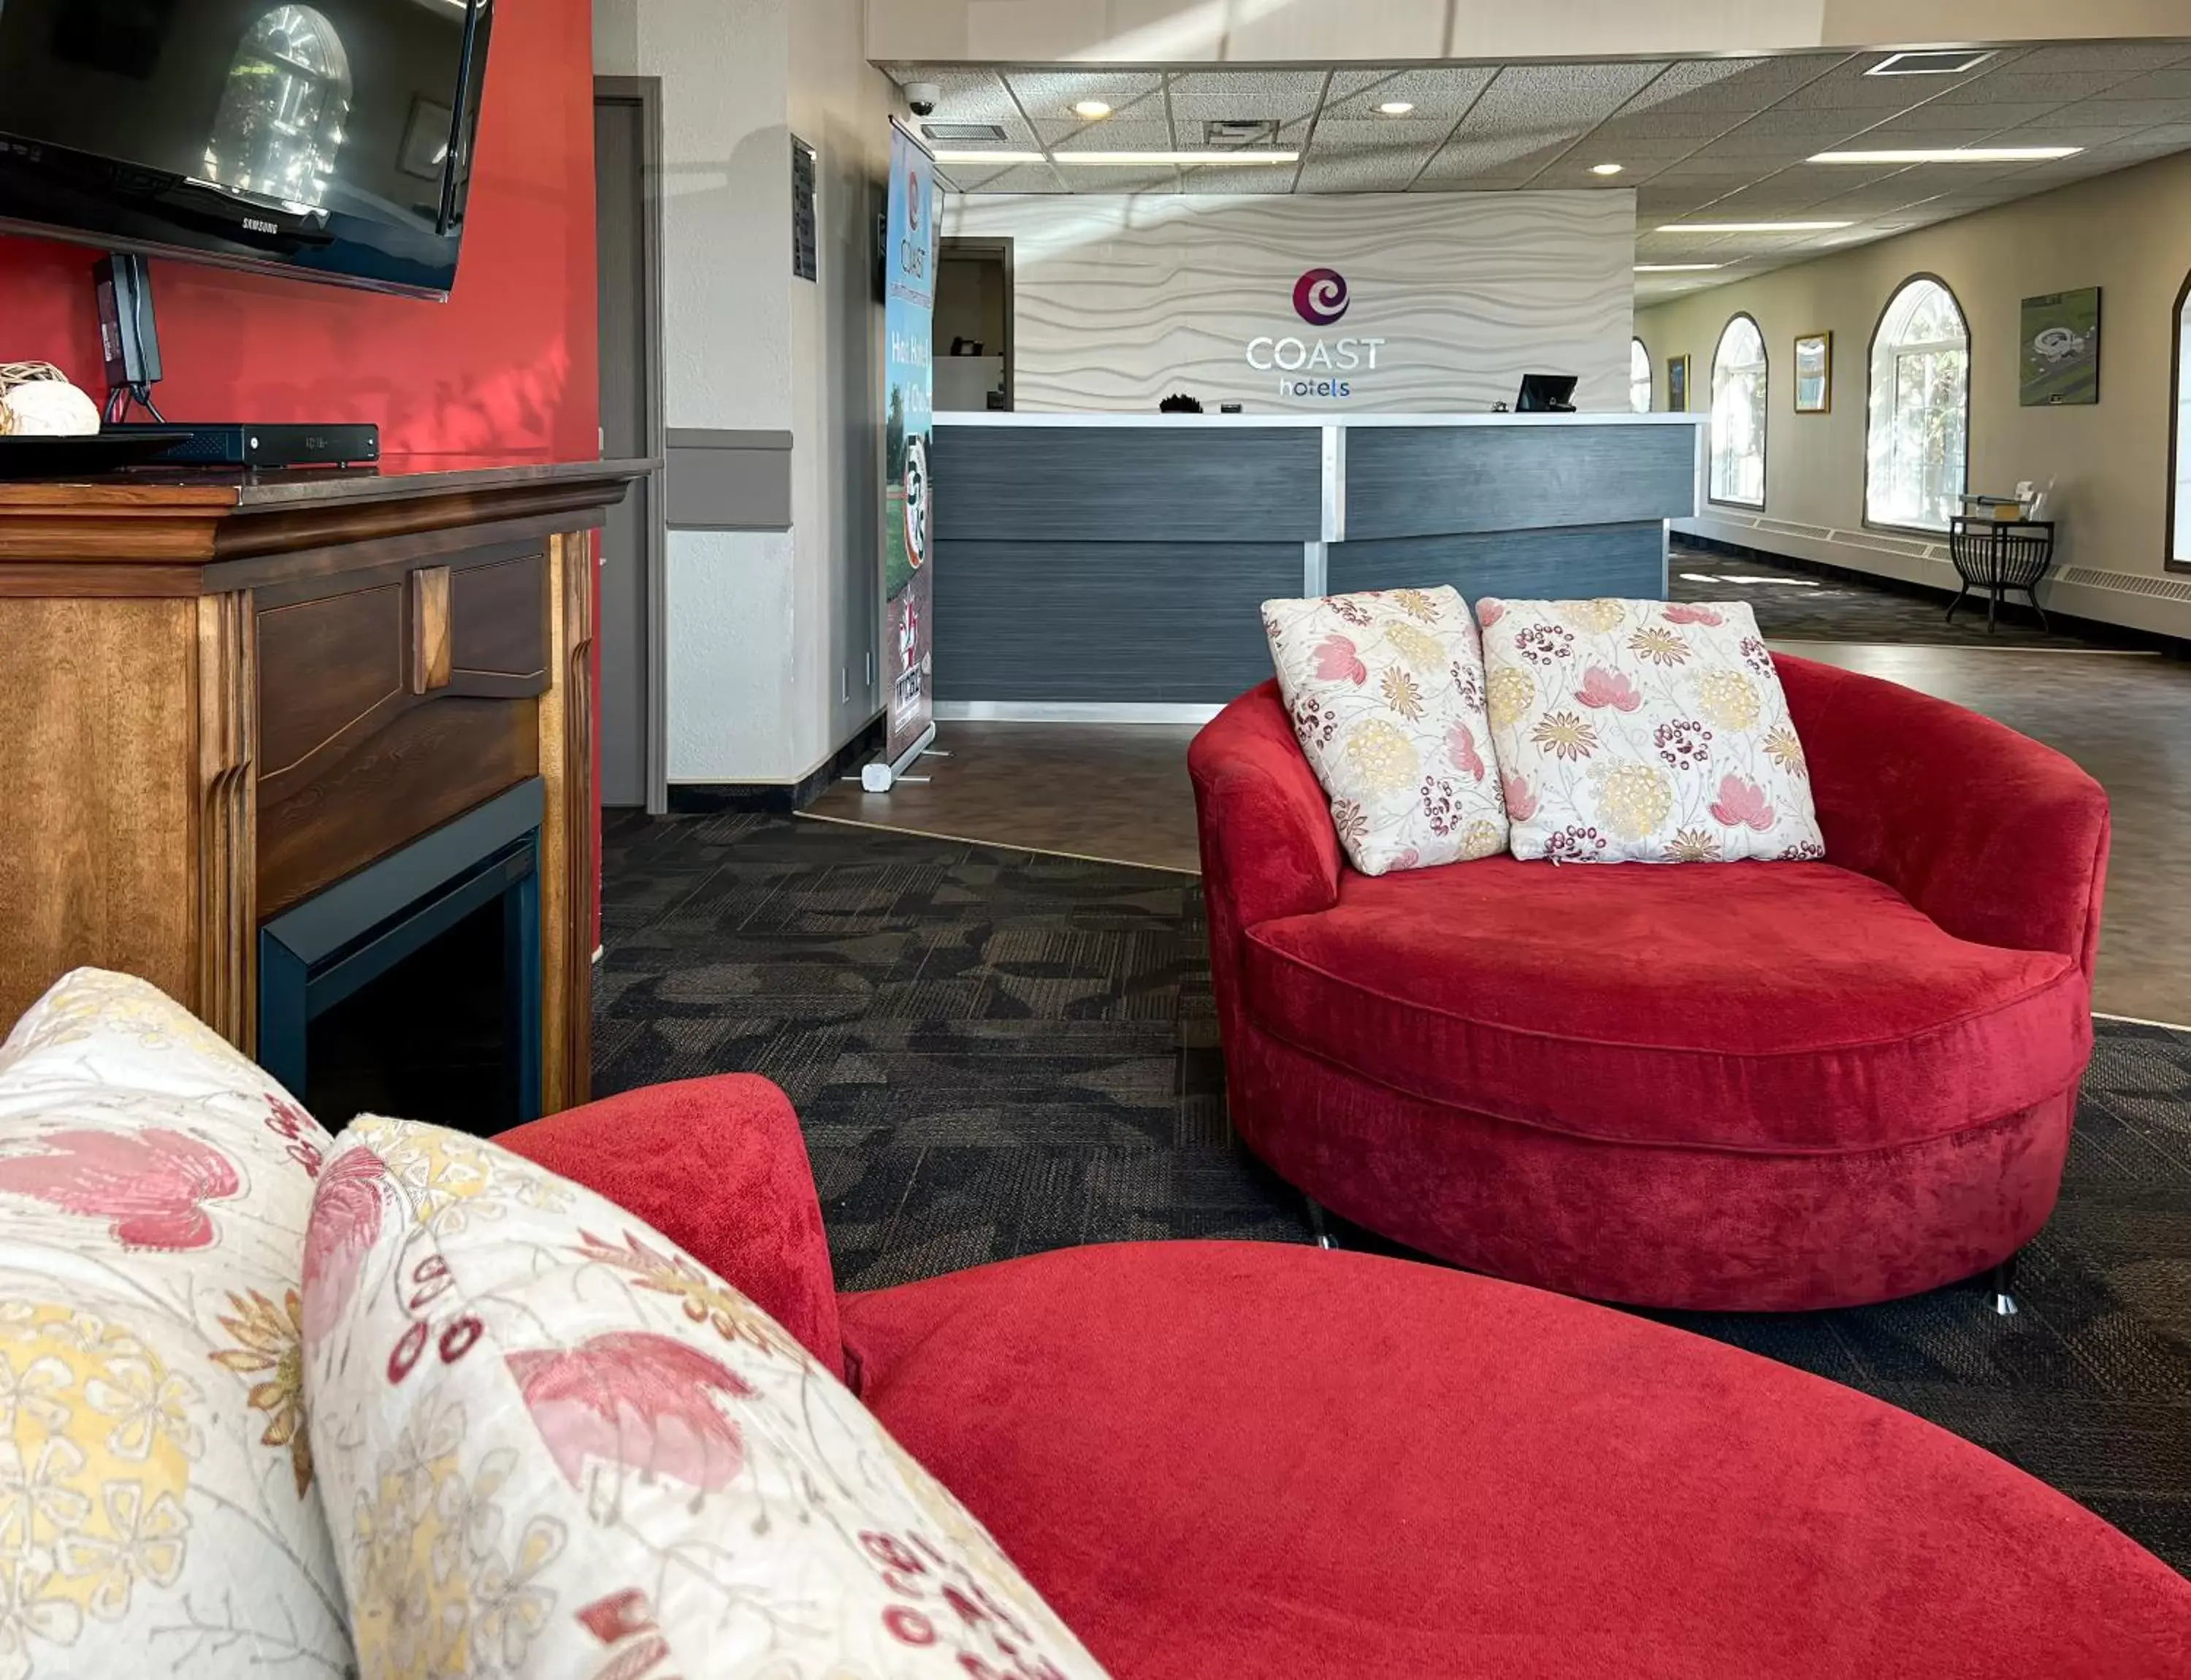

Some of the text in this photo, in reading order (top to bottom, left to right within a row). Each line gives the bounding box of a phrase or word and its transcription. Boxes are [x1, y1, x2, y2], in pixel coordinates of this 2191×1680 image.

[242, 218, 278, 234] SAMSUNG
[1246, 337, 1385, 370] COAST
[1280, 378, 1350, 397] hotels
